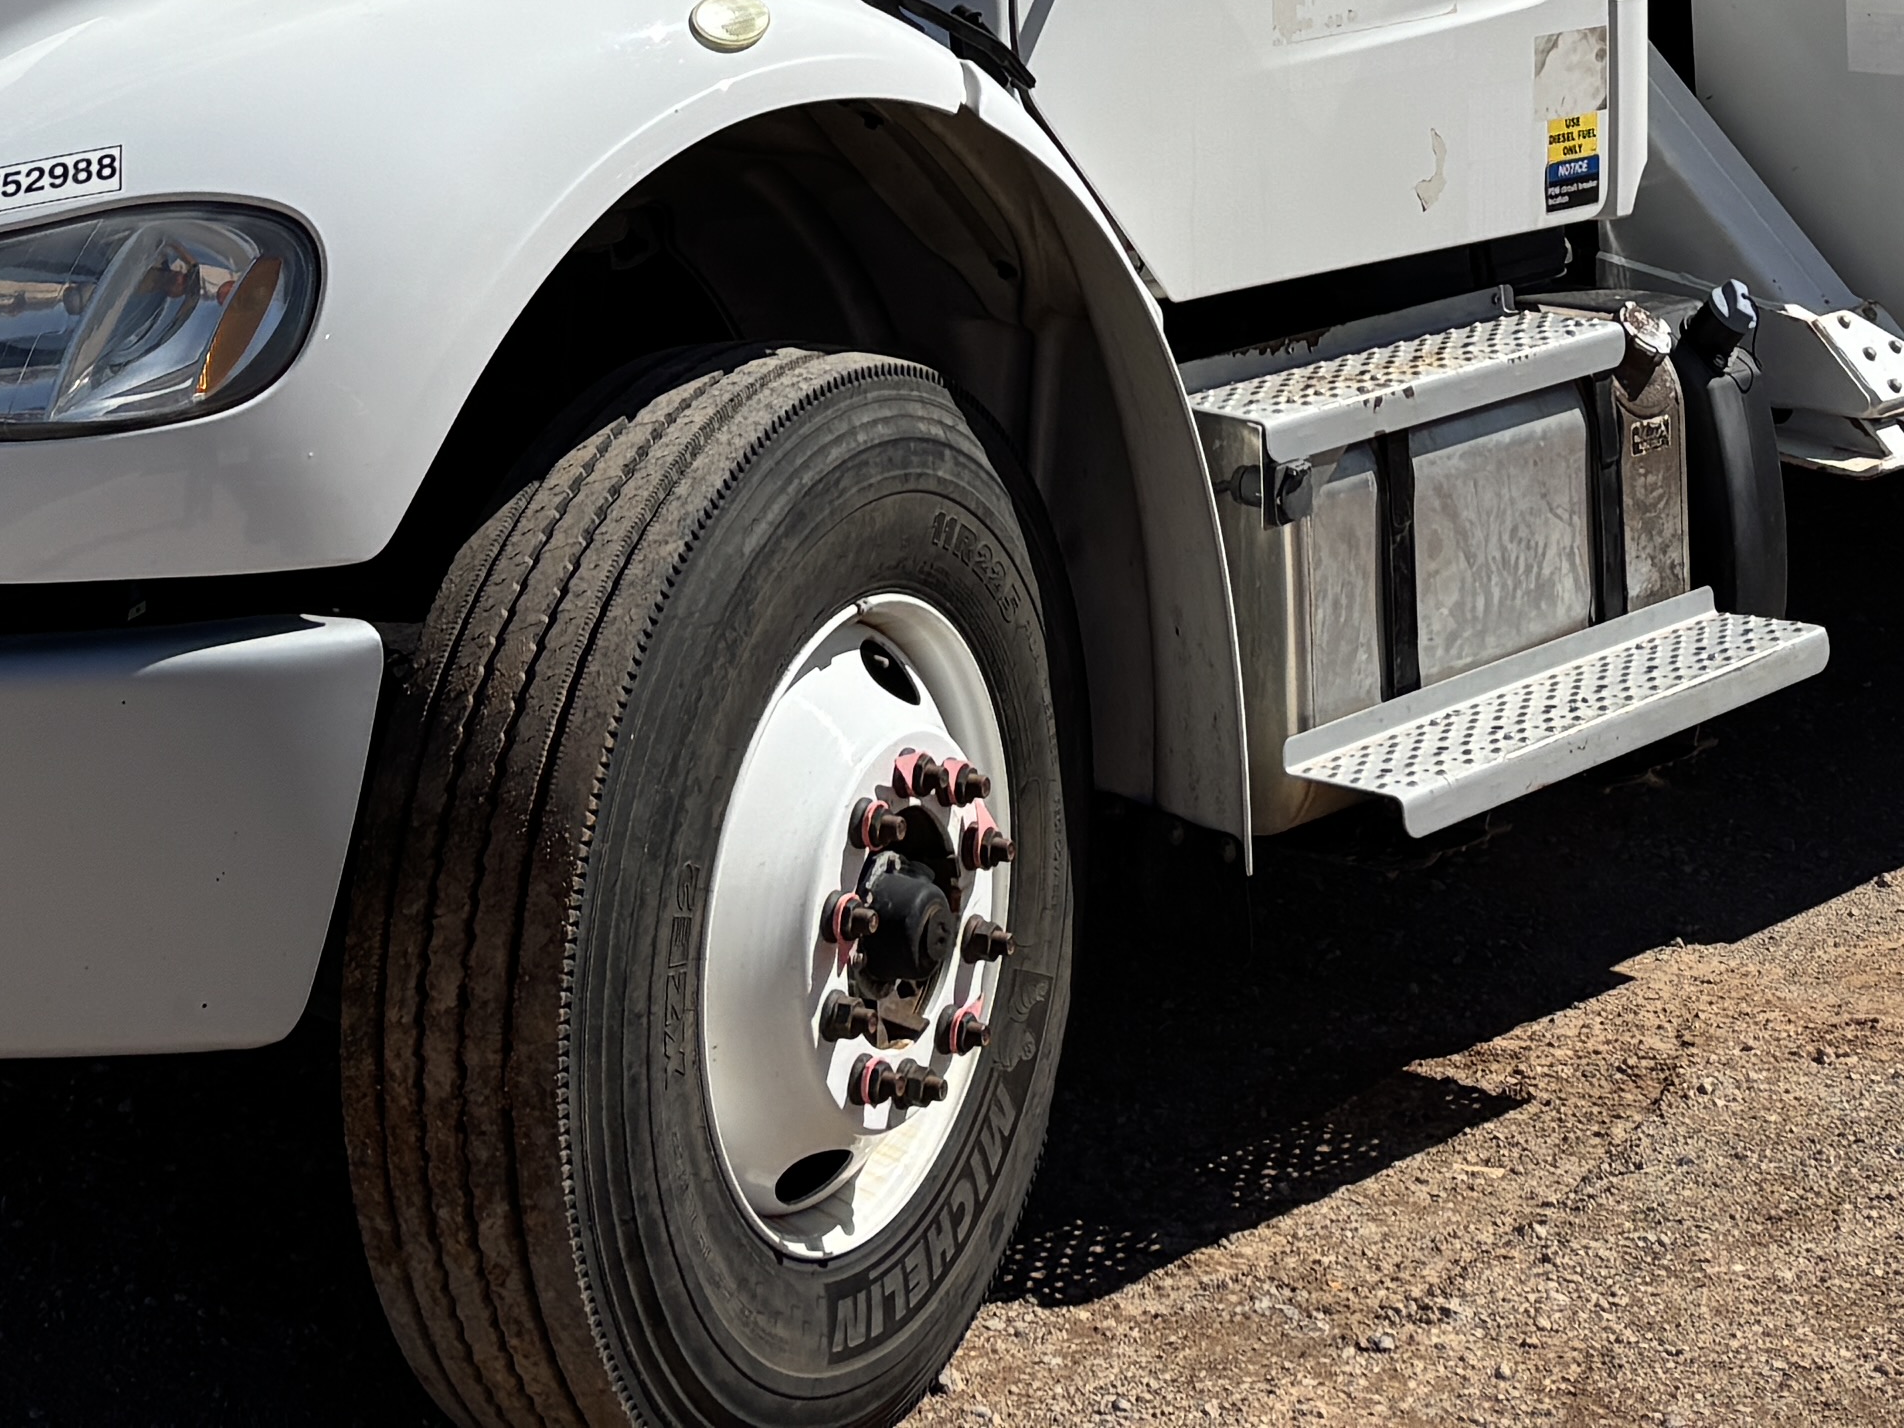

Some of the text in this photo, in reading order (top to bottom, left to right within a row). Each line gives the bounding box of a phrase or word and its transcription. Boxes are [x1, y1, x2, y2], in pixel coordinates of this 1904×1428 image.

[1565, 116, 1581, 129] USE
[1548, 127, 1597, 145] DIESEL FUEL
[1562, 143, 1584, 156] ONLY
[1557, 159, 1589, 177] NOTICE
[832, 1076, 1018, 1354] MICHELIN
